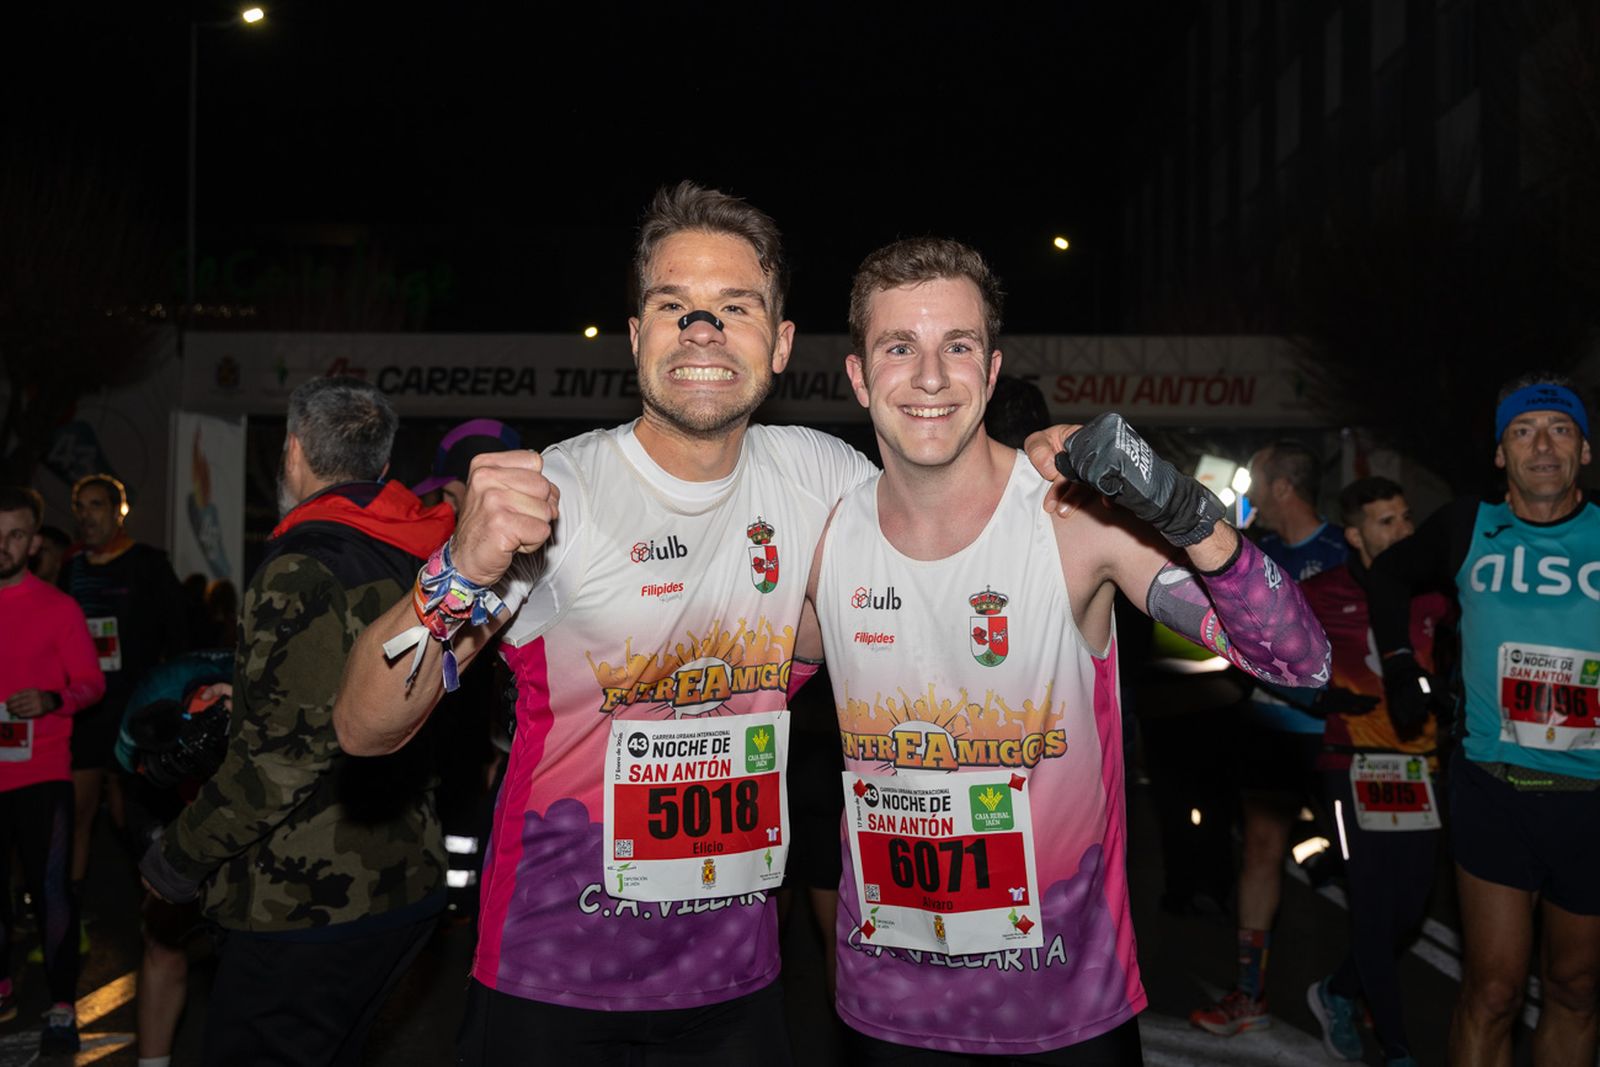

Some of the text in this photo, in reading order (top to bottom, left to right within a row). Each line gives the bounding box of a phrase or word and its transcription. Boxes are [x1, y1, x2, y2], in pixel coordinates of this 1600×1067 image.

[375, 366, 537, 397] CARRERA
[1053, 366, 1257, 406] SAN ANTÓN
[1510, 666, 1531, 678] SAN
[1560, 660, 1574, 671] DE
[627, 735, 649, 752] 43
[652, 737, 731, 759] NOCHE DE
[629, 756, 732, 783] SAN ANTÓN
[863, 788, 878, 801] 43
[882, 795, 951, 813] NOCHE DE
[1368, 782, 1416, 804] 9815
[648, 780, 759, 839] 5018
[868, 813, 953, 836] SAN ANTÓN
[693, 841, 724, 855] Elicio
[888, 838, 990, 893] 6071
